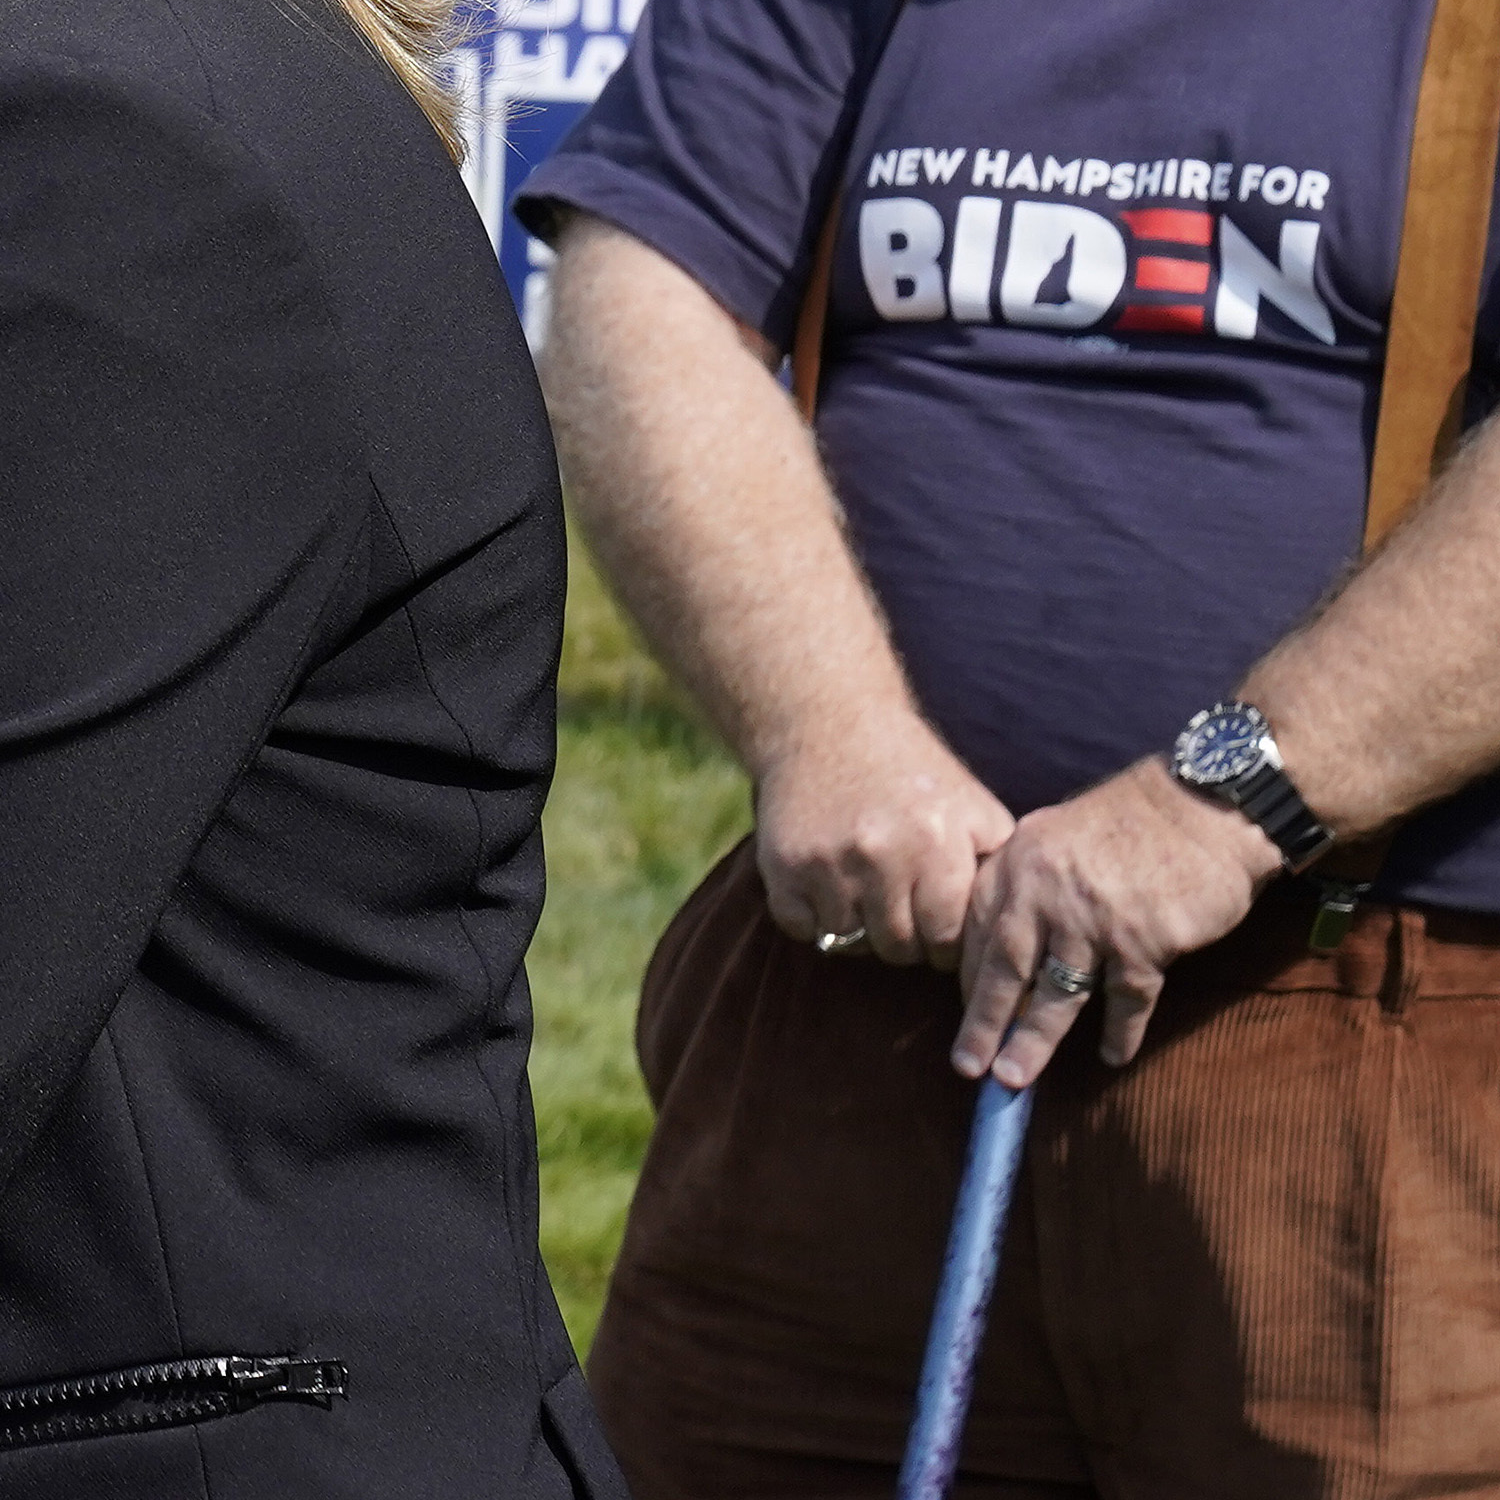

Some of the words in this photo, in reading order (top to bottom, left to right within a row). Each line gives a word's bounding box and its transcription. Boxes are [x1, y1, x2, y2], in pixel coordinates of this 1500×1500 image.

[867, 147, 966, 188] NEW
[971, 148, 1234, 200] HAMPSHIRE
[1238, 164, 1331, 209] FOR
[858, 196, 1338, 347] BIDEN
